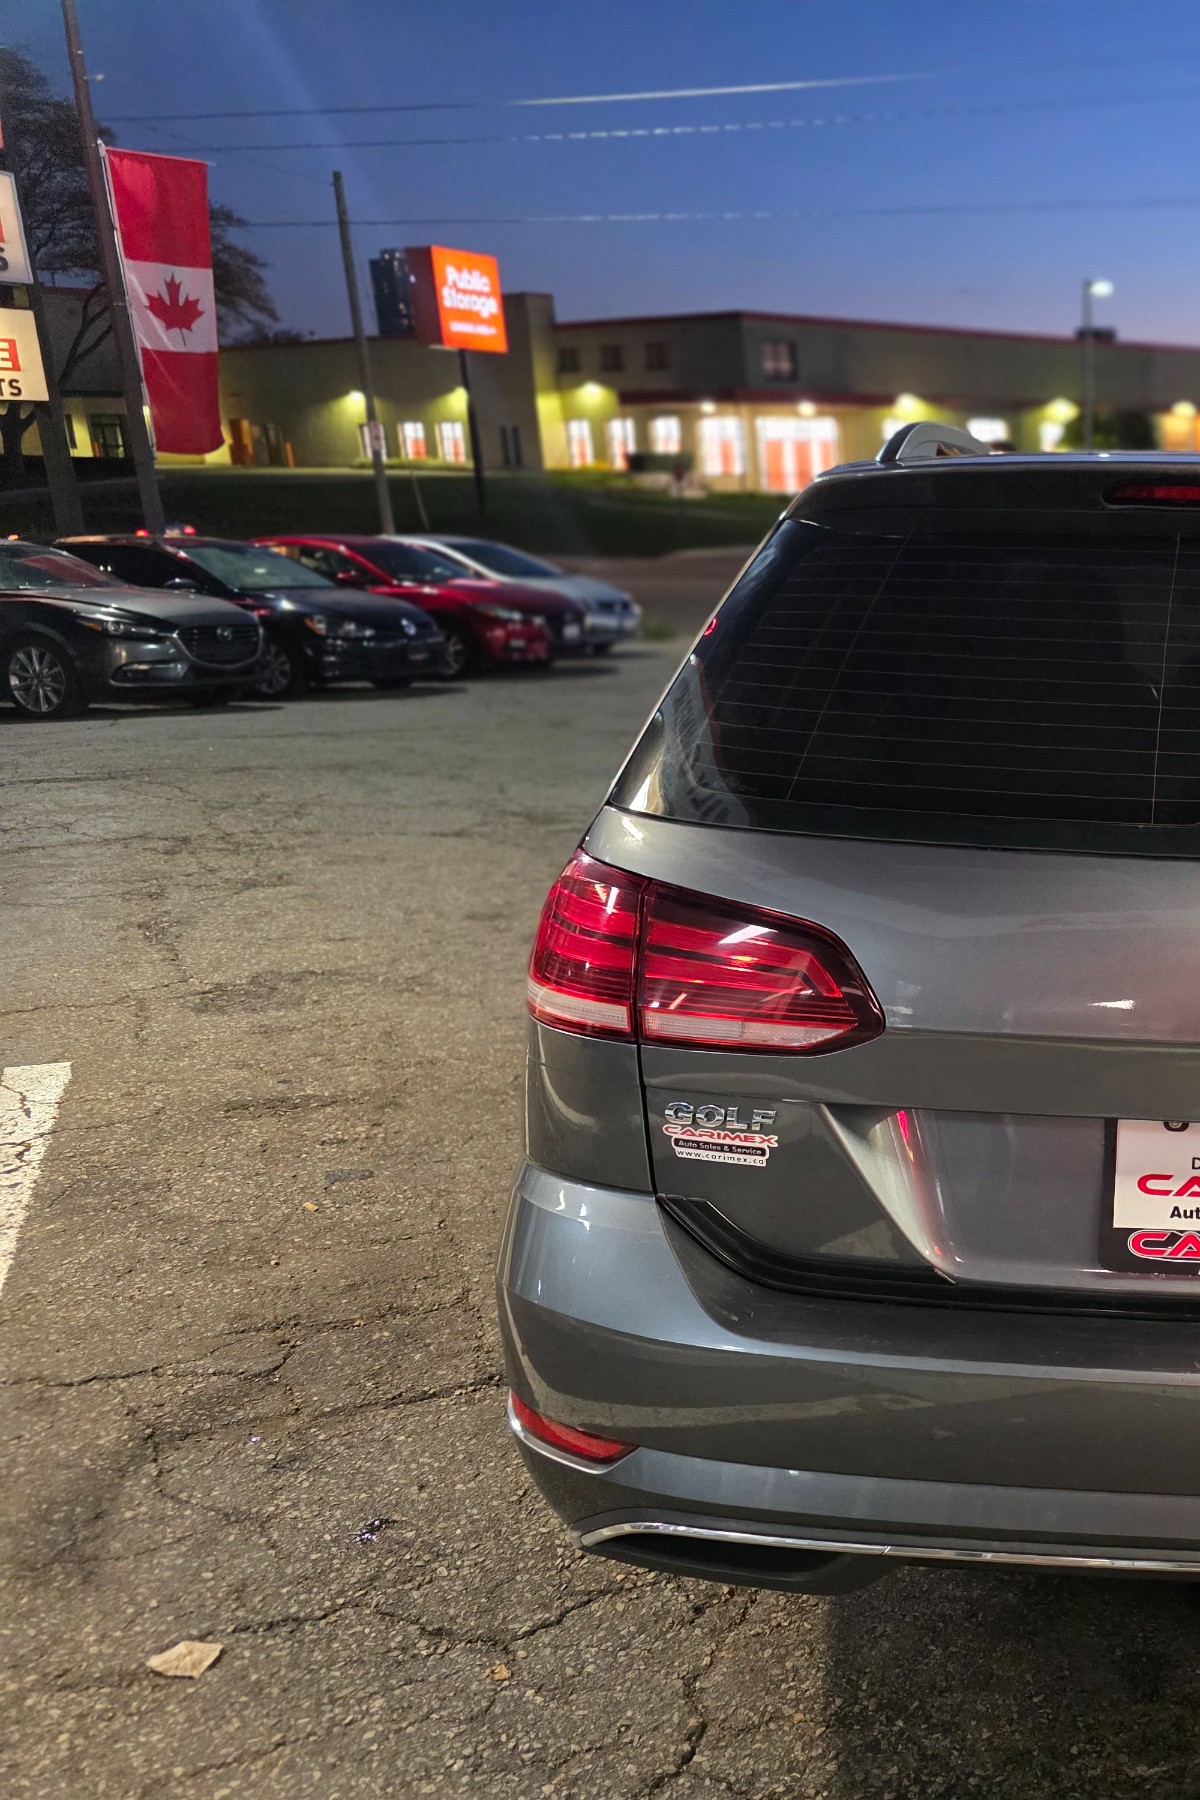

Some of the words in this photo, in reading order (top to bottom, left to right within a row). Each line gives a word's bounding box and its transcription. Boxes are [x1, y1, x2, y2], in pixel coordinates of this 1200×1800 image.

[664, 1101, 777, 1131] GOLF
[664, 1125, 777, 1146] CARIMEX
[678, 1140, 697, 1149] Auto
[699, 1143, 721, 1151] Sales
[732, 1146, 762, 1155] Service
[677, 1150, 764, 1165] www.carimex.ca
